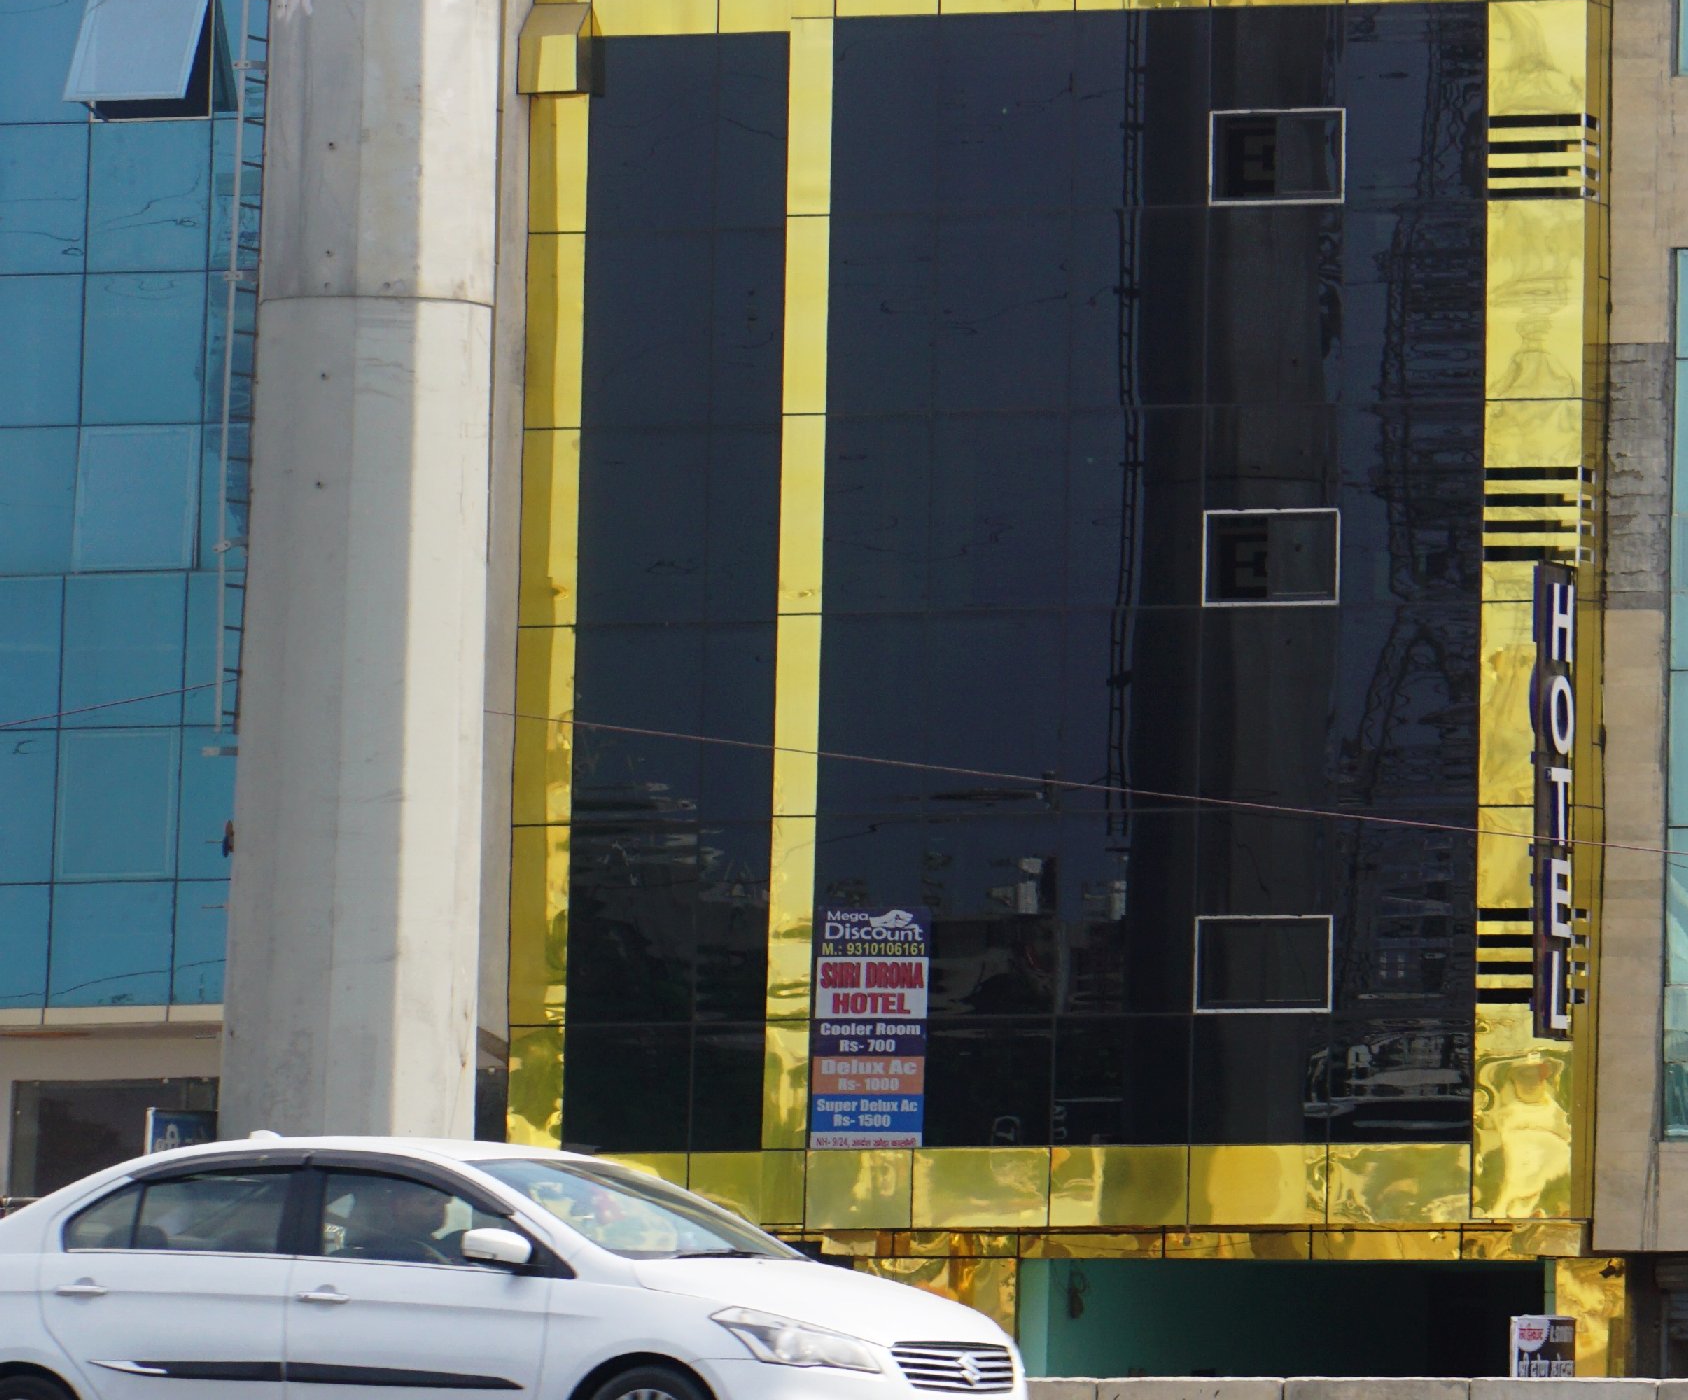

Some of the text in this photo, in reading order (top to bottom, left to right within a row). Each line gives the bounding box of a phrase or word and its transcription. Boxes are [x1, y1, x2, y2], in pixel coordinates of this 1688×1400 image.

[1546, 582, 1575, 1030] HOTEL
[827, 910, 868, 922] Mega
[824, 922, 924, 941] Discount
[820, 961, 924, 989] SHRI DRONA
[832, 992, 911, 1015] HOTEL
[820, 1022, 921, 1036] Cooler Room
[839, 1039, 897, 1052] Rs- 700
[821, 1059, 917, 1075] Delux Ac
[838, 1077, 900, 1091] Rs- 1000
[816, 1098, 918, 1113] Super Delux Ac
[832, 1113, 892, 1127] Rs- 1500
